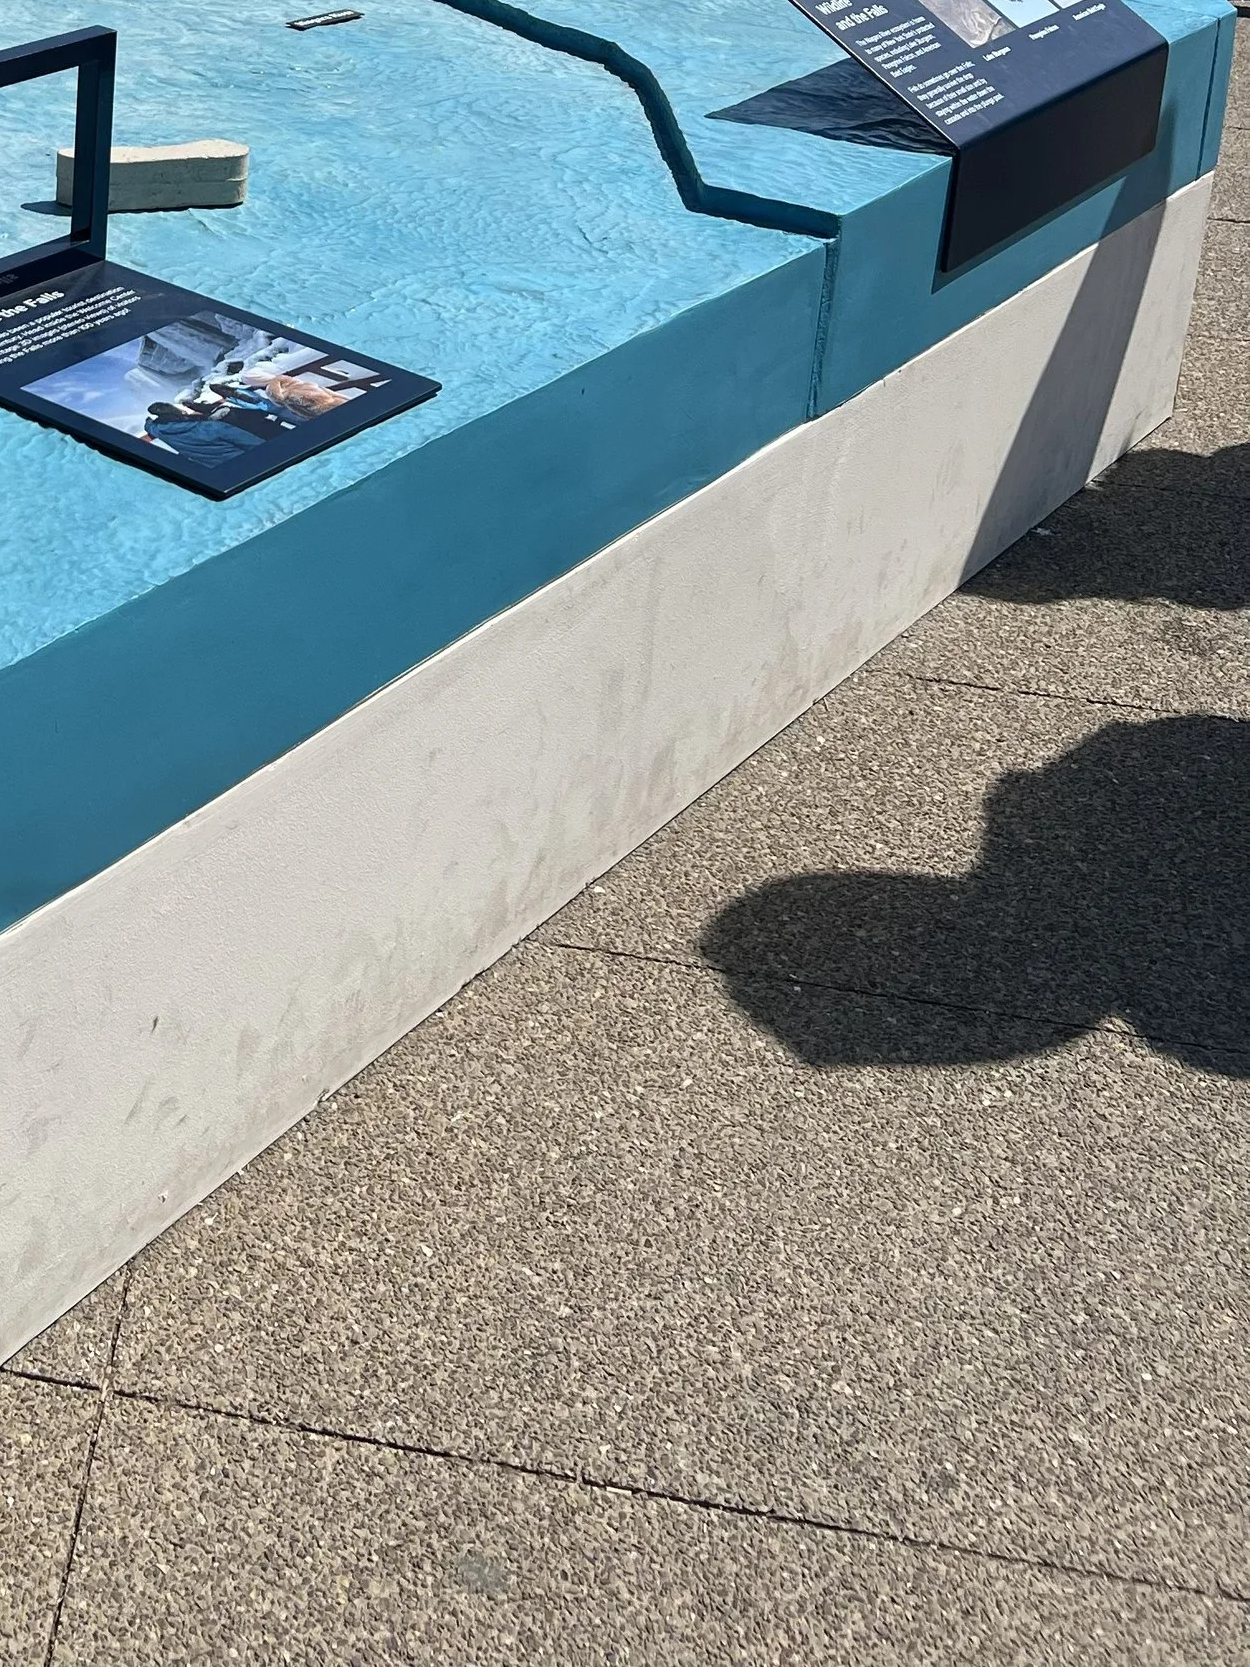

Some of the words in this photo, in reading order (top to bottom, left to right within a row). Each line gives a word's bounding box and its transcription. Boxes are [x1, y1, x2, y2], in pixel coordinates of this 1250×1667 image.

[835, 15, 856, 30] and
[849, 12, 869, 24] the
[862, 4, 888, 18] Falls
[6, 323, 29, 333] been
[34, 309, 63, 324] popular
[85, 286, 124, 303] destination
[22, 290, 64, 307] Falls
[20, 325, 44, 336] Head
[76, 299, 112, 314] Welcome
[109, 289, 135, 300] Center
[17, 338, 32, 346] 3D
[21, 343, 43, 353] Falls
[41, 335, 63, 345] more
[60, 328, 80, 337] than
